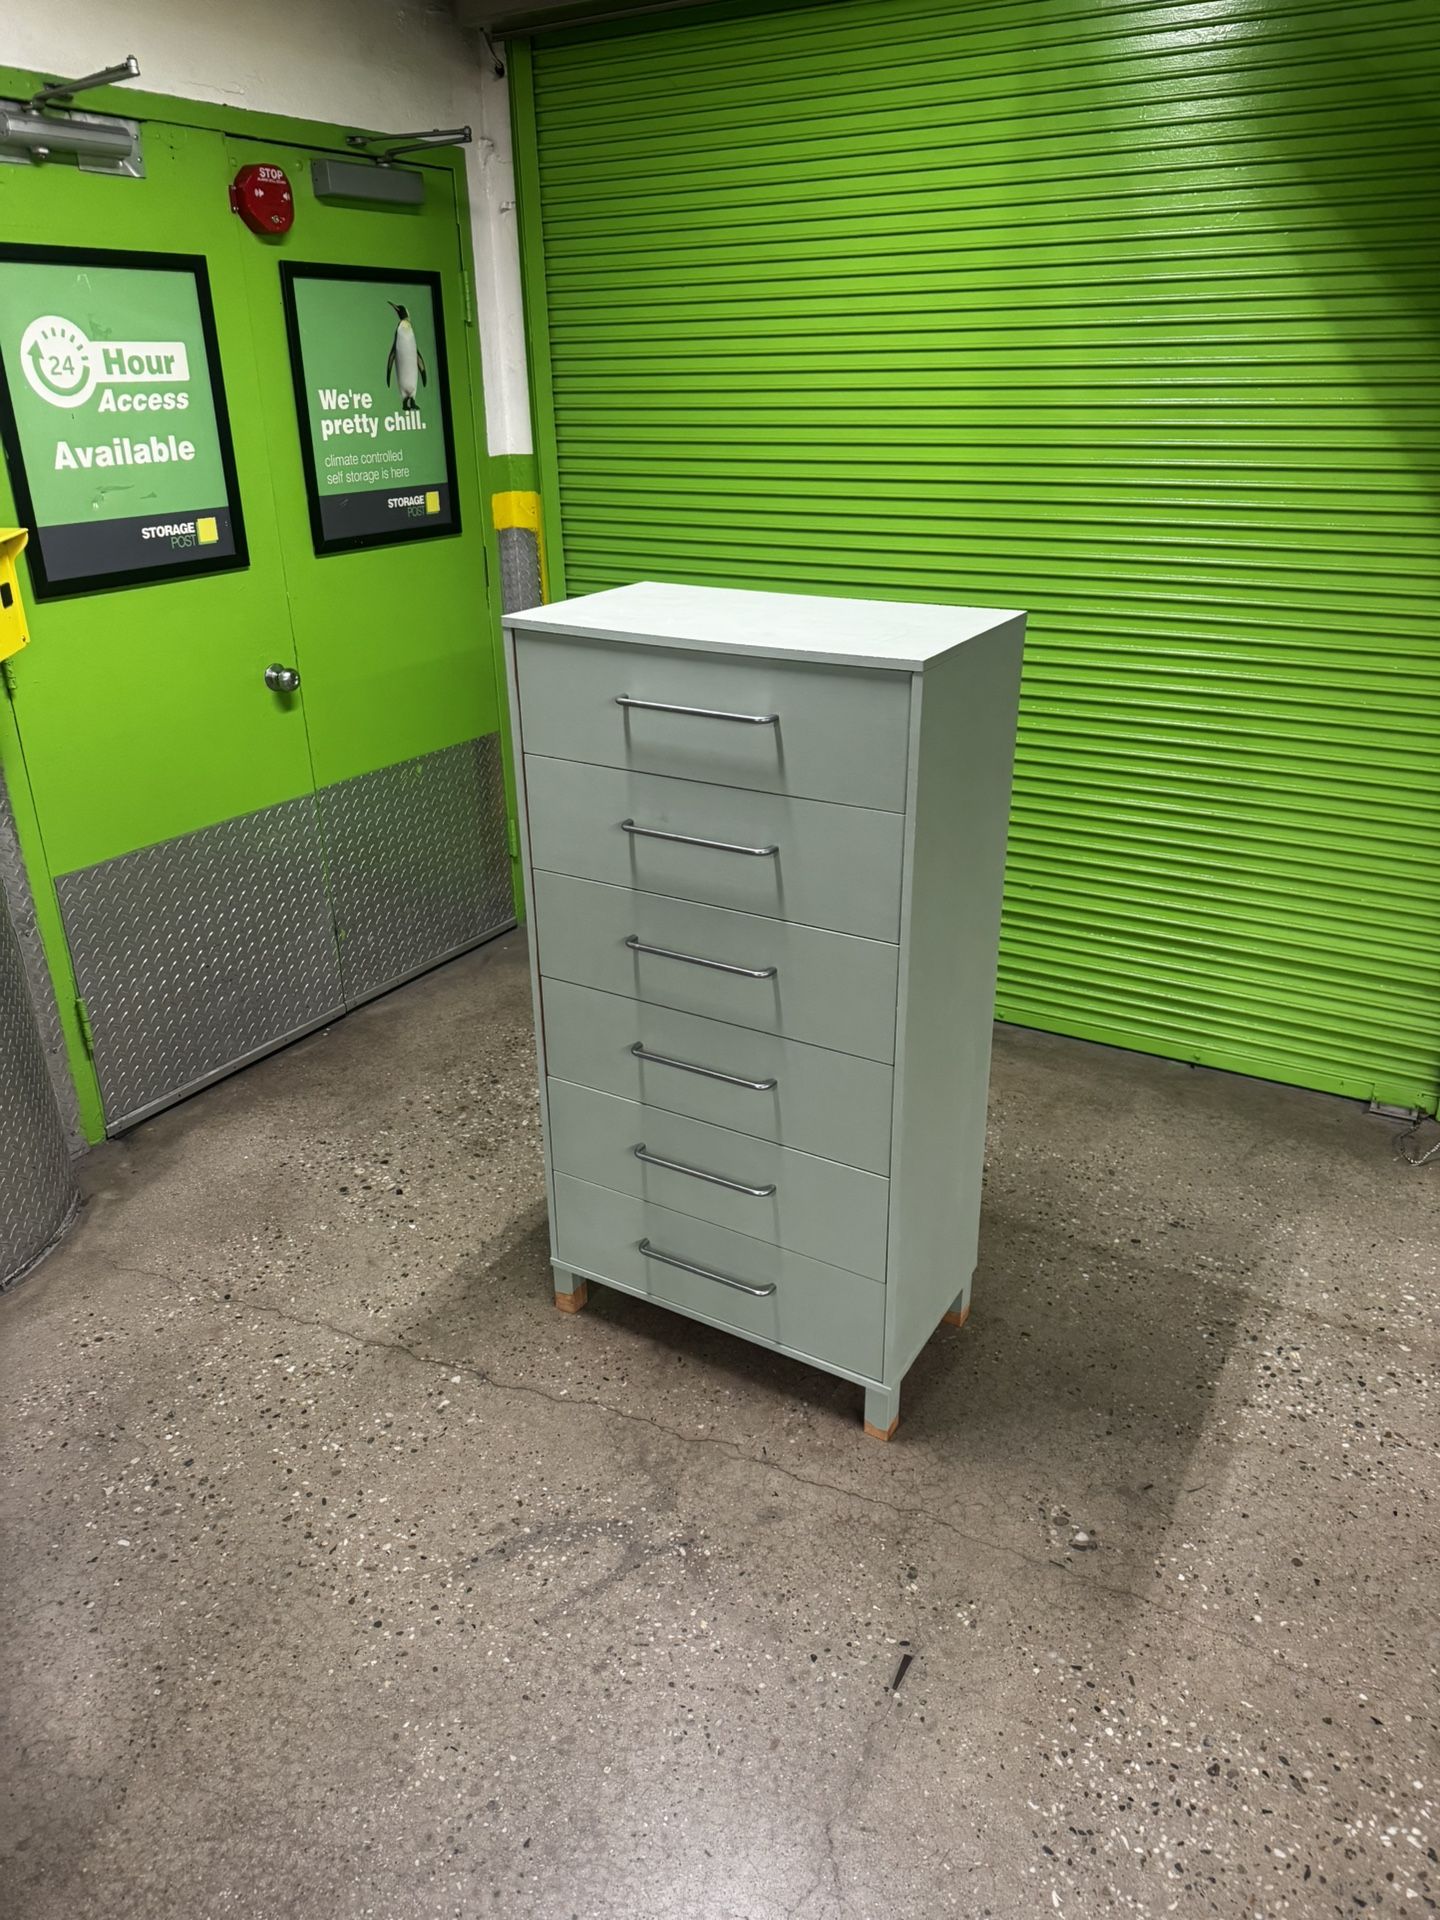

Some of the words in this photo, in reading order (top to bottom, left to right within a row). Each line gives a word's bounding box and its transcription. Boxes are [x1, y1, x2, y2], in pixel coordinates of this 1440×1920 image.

[259, 167, 283, 179] STOP
[48, 355, 75, 376] 24
[102, 348, 175, 375] Hour
[97, 388, 189, 413] Access
[318, 388, 373, 410] We're
[321, 413, 379, 441] pretty
[384, 410, 427, 432] chill.
[54, 435, 196, 470] Available
[324, 453, 359, 468] climate
[360, 448, 403, 465] controlled
[326, 470, 344, 485] self
[346, 470, 380, 484] storage
[381, 467, 389, 479] is
[391, 467, 410, 479] here
[388, 495, 425, 508] STORAGE
[408, 506, 425, 518] POST
[141, 522, 196, 540] STORAGE
[170, 534, 196, 549] POST
